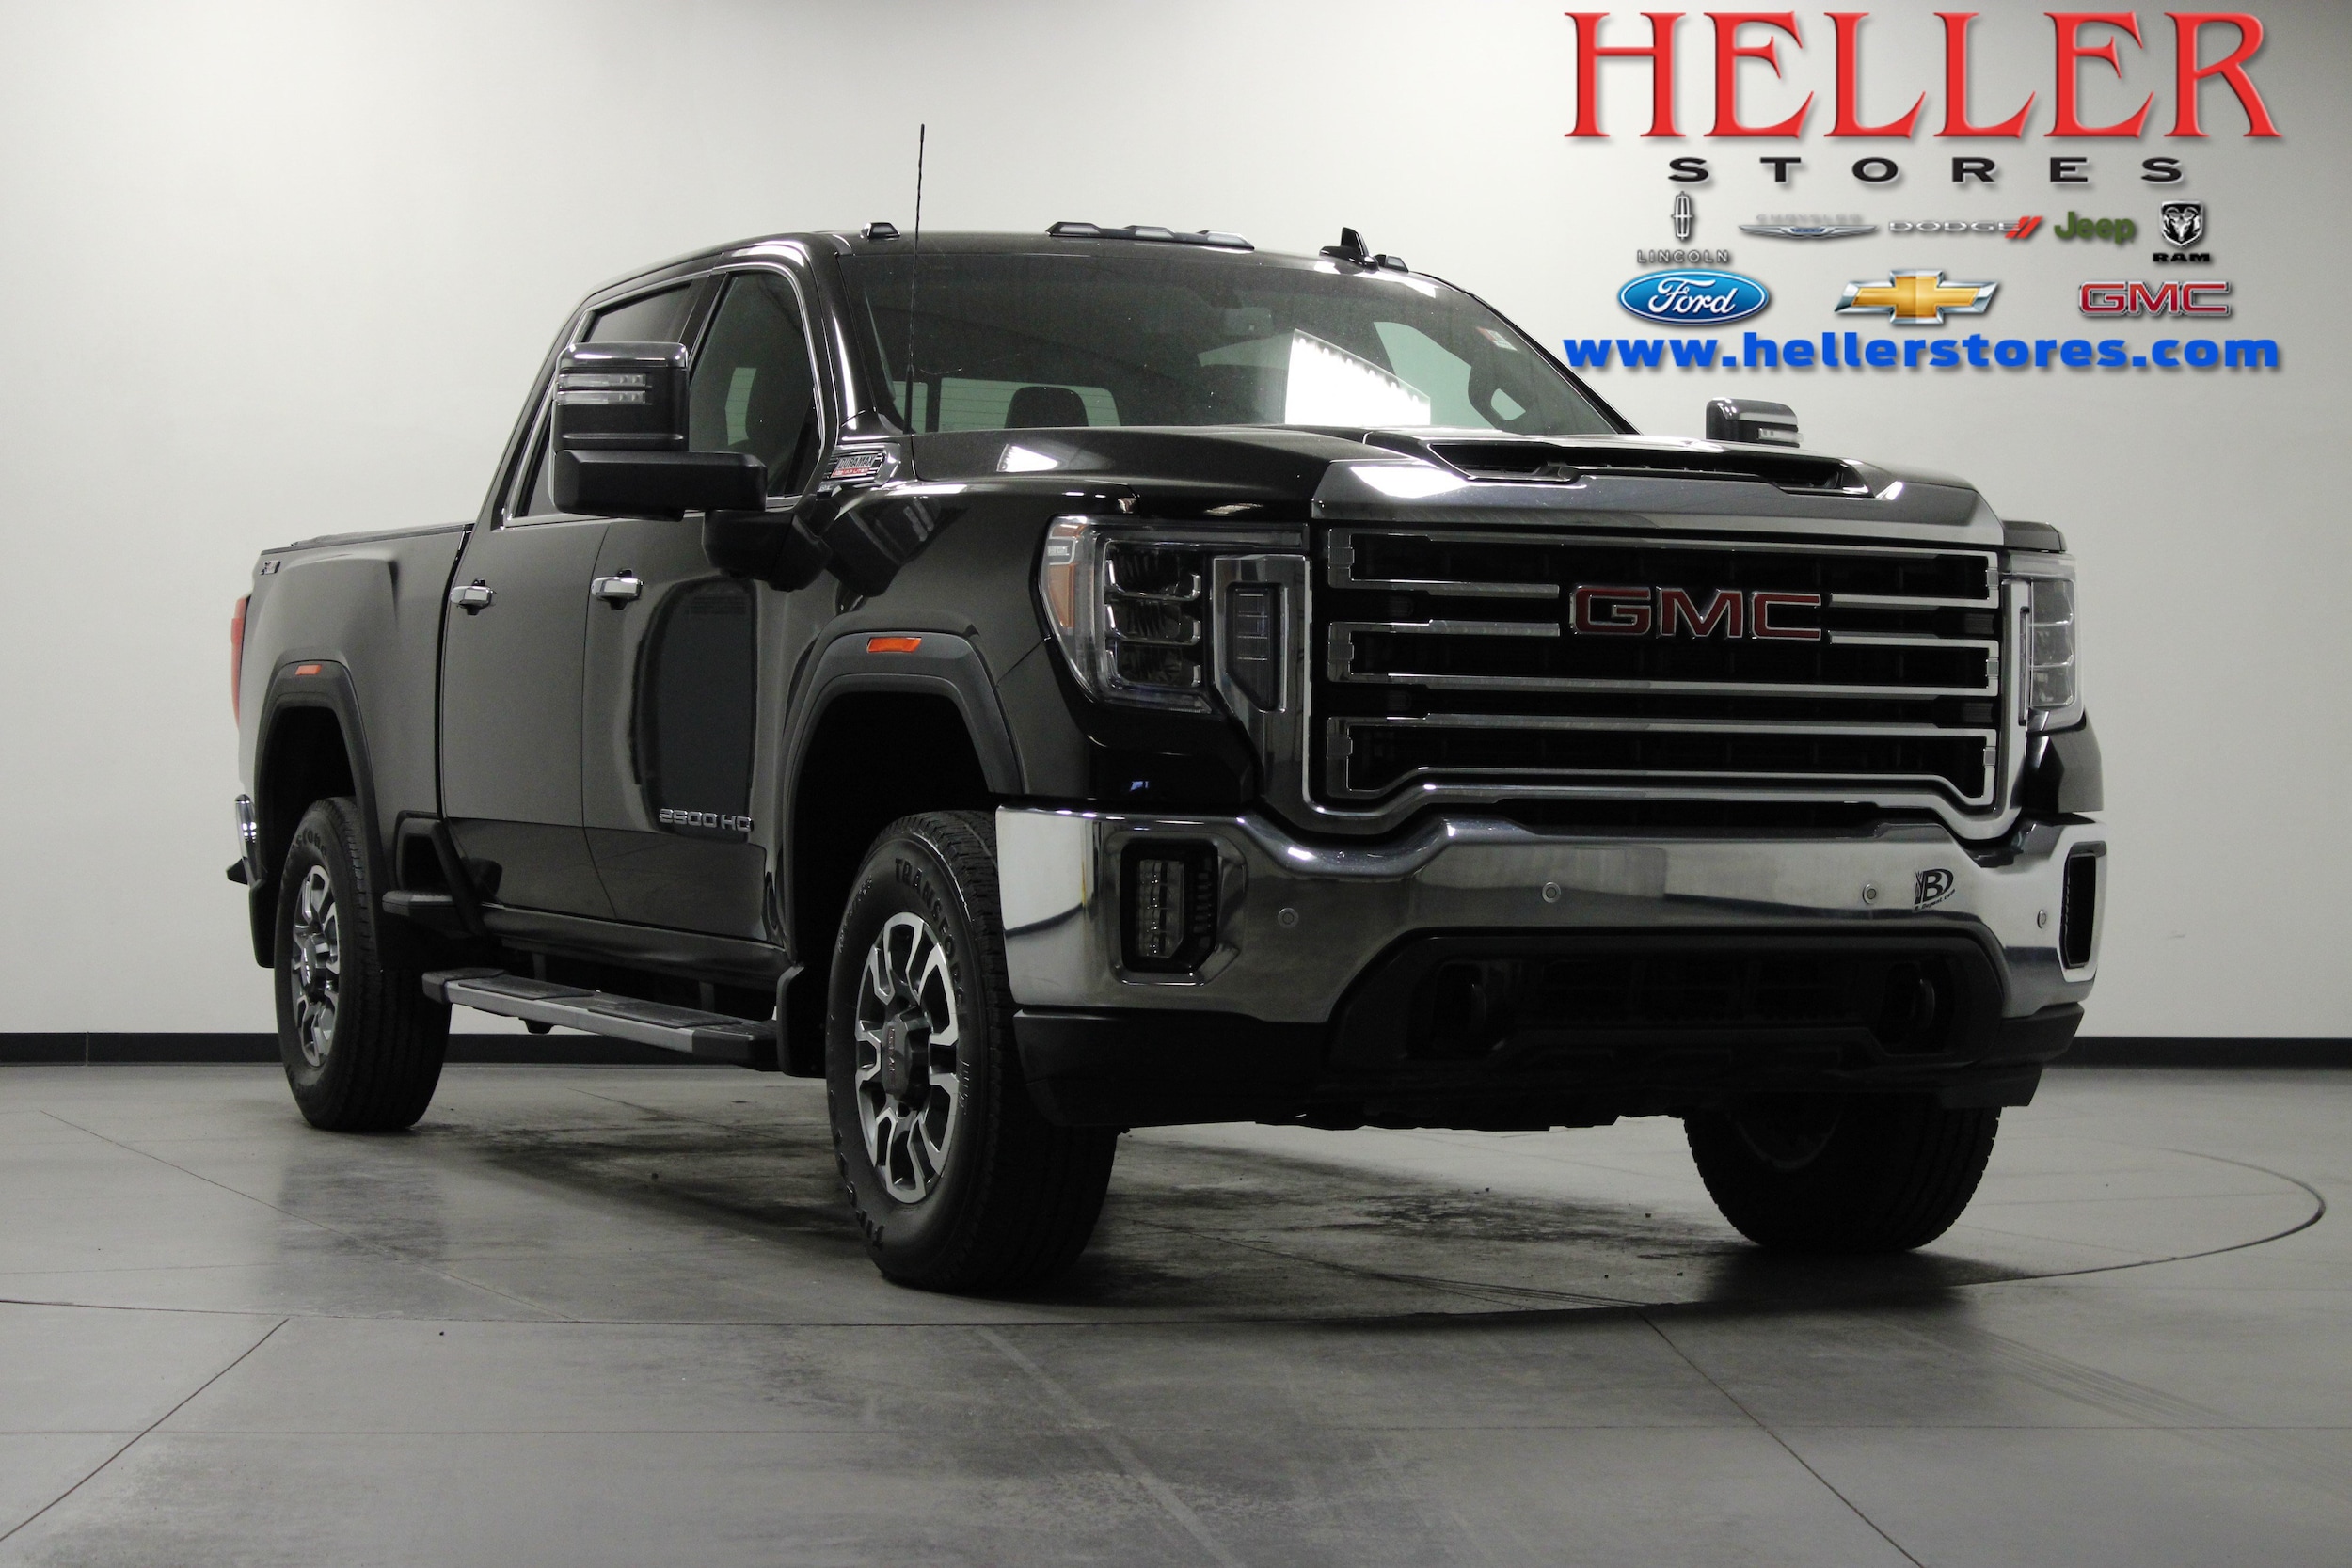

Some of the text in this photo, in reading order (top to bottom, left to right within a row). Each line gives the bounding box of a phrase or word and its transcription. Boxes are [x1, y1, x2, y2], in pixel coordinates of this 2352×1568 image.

[1569, 585, 1822, 641] GMC
[659, 808, 753, 832] 2500 HD
